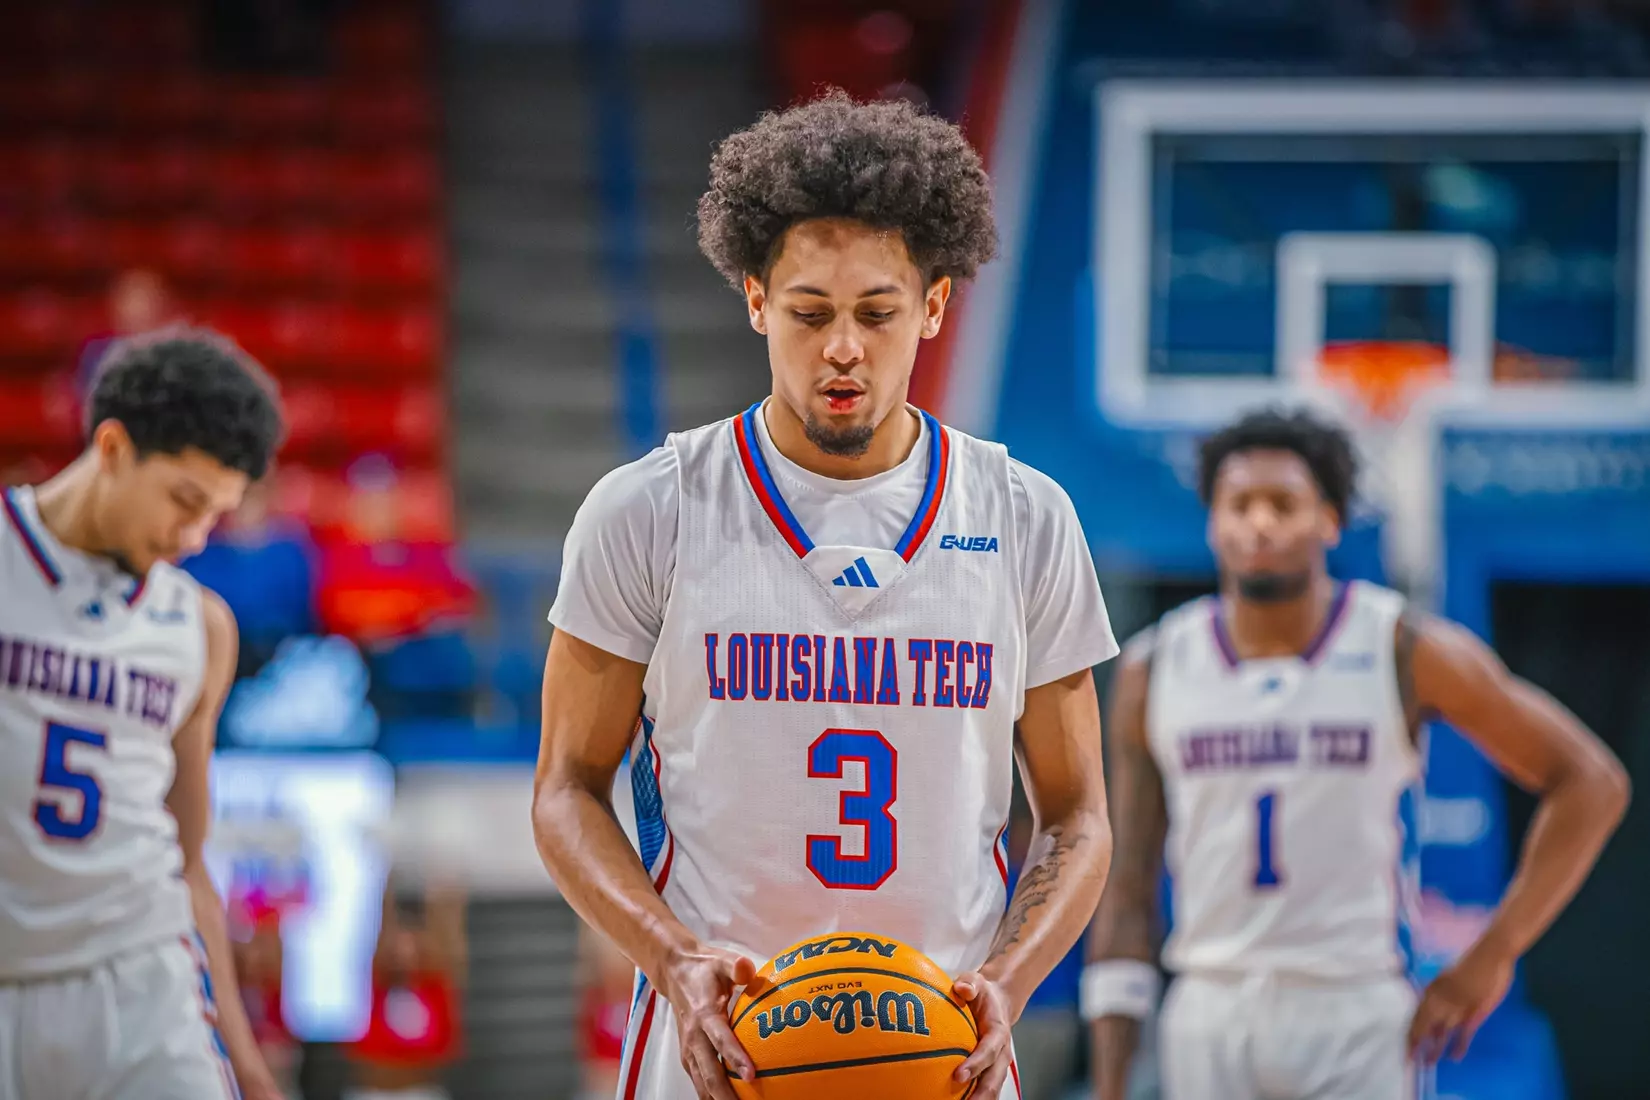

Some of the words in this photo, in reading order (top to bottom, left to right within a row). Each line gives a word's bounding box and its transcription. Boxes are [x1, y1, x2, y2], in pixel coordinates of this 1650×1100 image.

[704, 632, 901, 705] LOUISIANA
[908, 638, 994, 709] TECH
[31, 719, 108, 842] 5
[806, 728, 898, 890] 3
[1252, 791, 1284, 889] 1
[774, 936, 898, 973] NCAA
[837, 981, 862, 989] EVO
[756, 990, 931, 1040] Wilson
[808, 983, 834, 994] NXT
